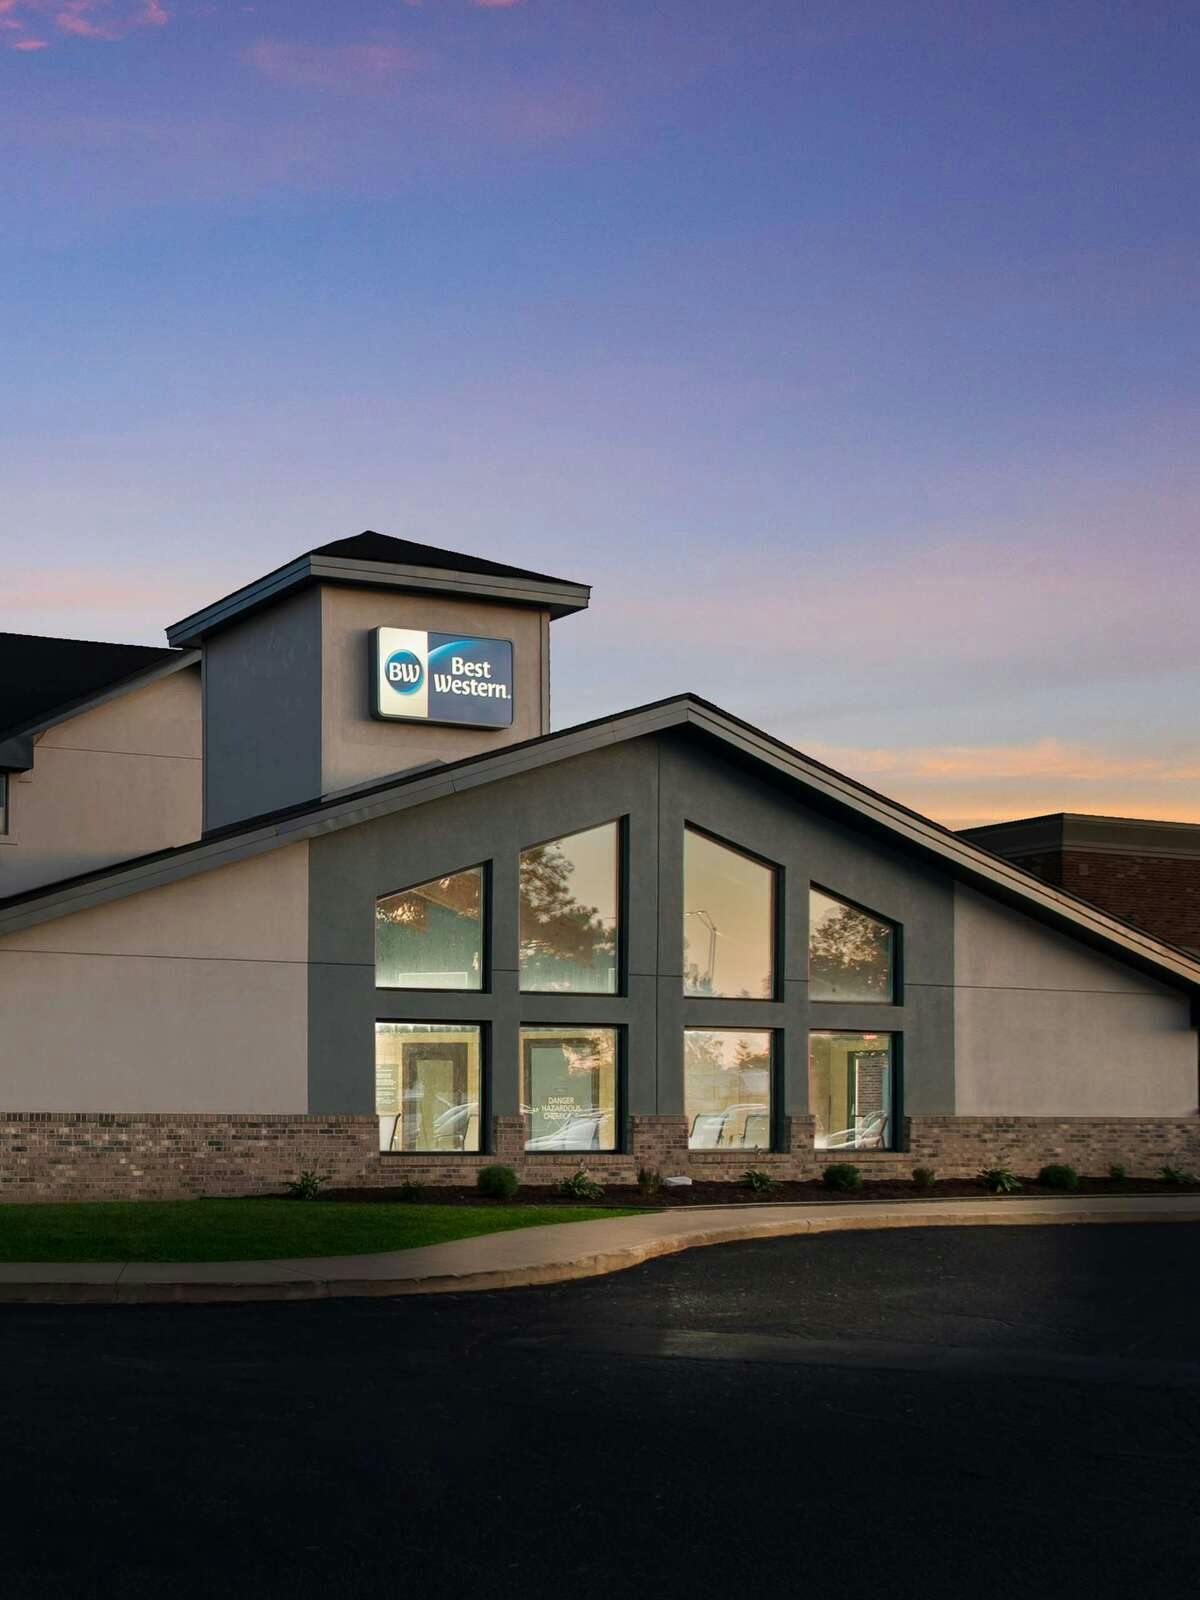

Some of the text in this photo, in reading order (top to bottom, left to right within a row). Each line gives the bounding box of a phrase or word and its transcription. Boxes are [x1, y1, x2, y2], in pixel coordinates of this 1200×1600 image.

[389, 662, 420, 683] BW
[452, 656, 491, 679] Best
[548, 1096, 575, 1104] DANGER
